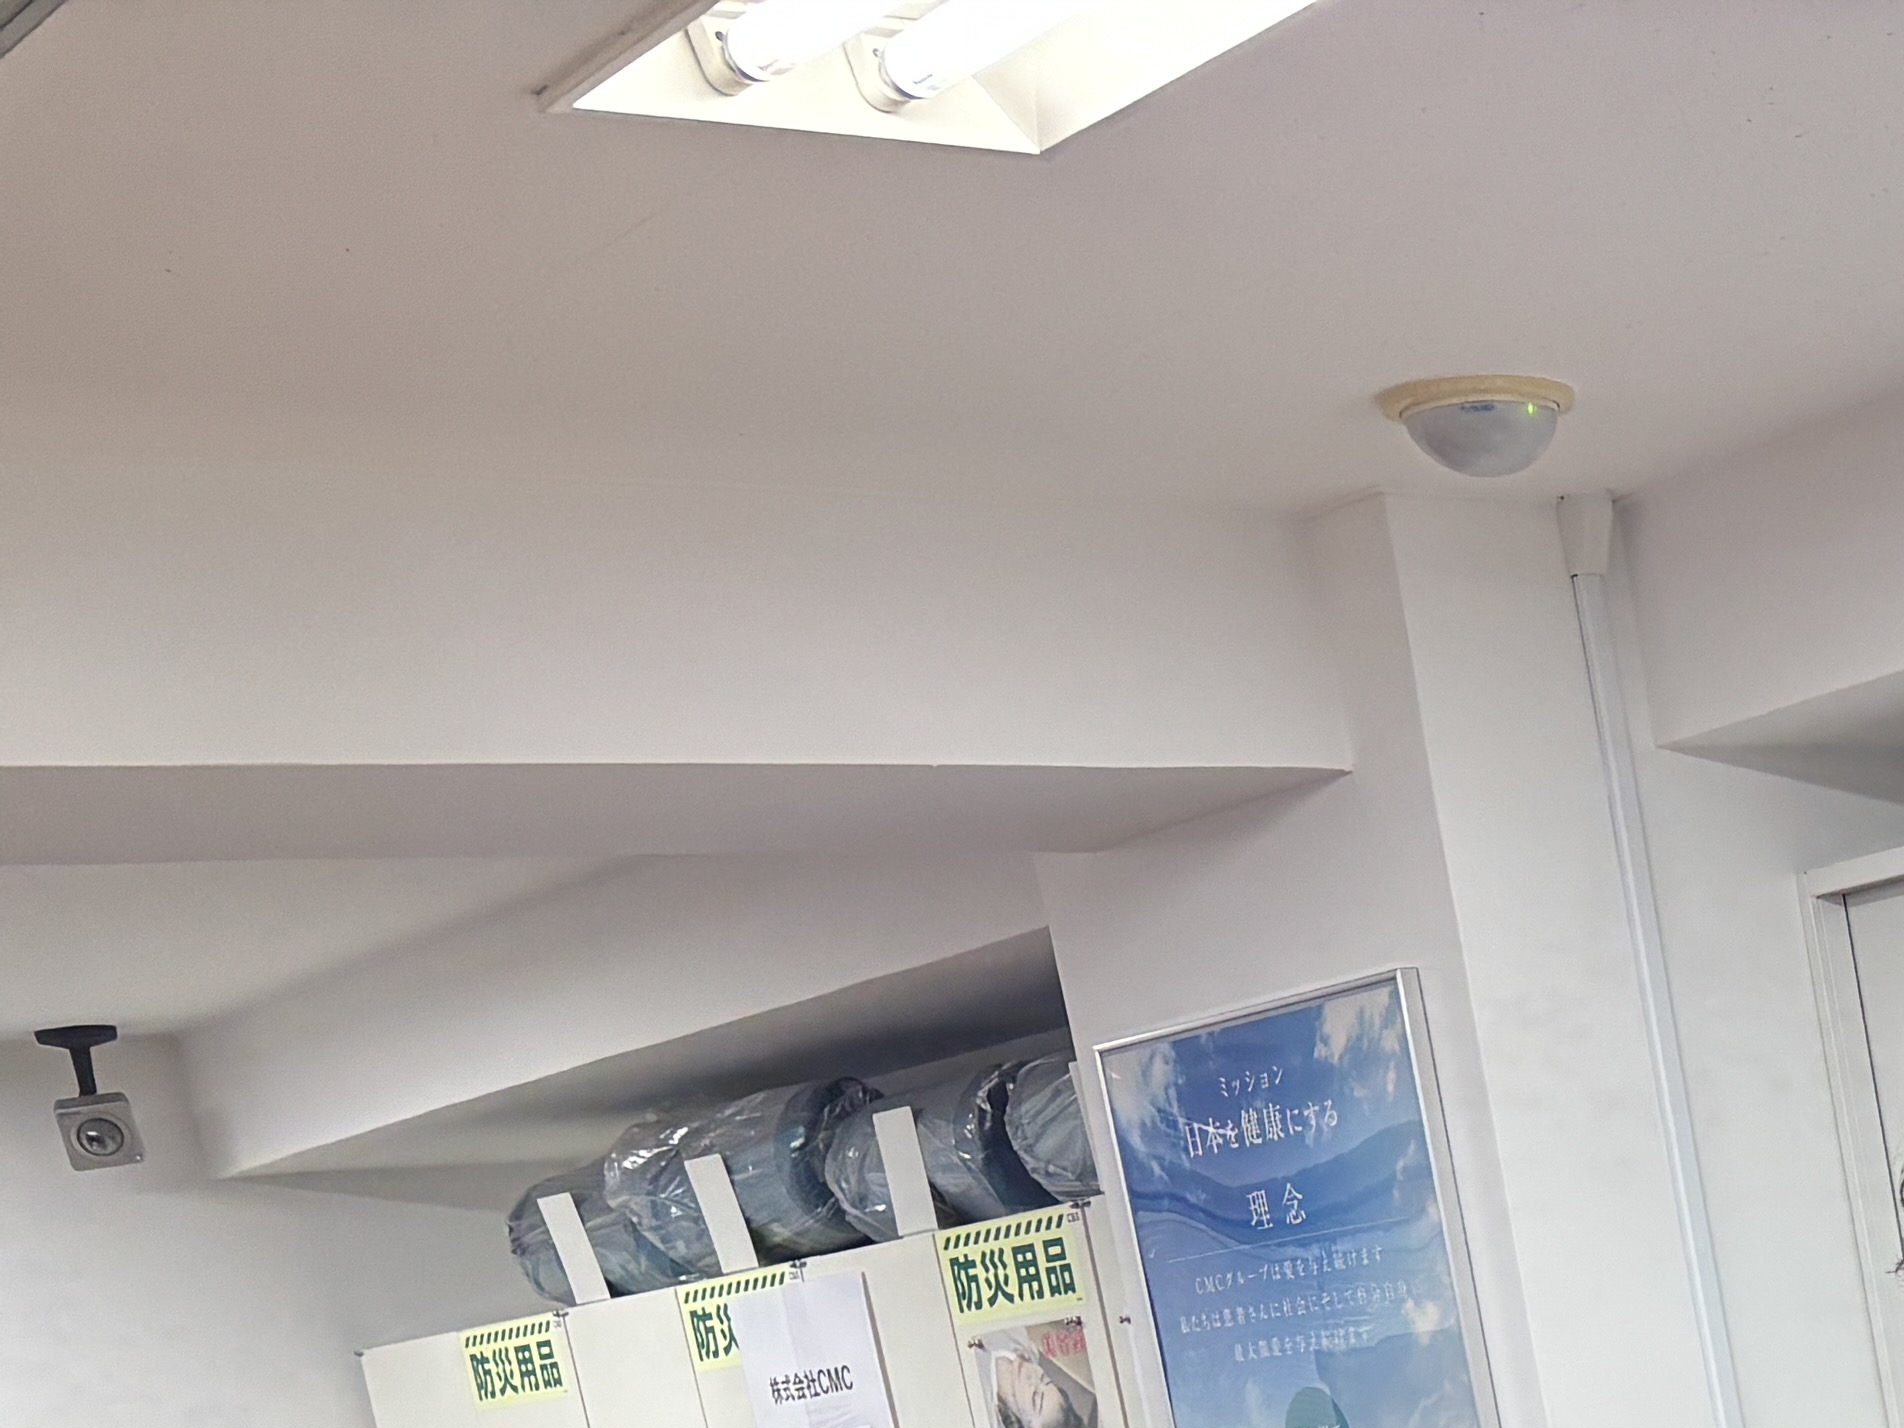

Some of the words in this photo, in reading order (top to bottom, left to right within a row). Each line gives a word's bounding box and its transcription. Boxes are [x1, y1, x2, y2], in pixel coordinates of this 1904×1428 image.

[1218, 1066, 1283, 1097] ミッション
[1184, 1099, 1338, 1158] 日本を健康にする
[1246, 1182, 1306, 1231] 理念
[948, 1237, 1076, 1314] 防災用品
[469, 1339, 563, 1402] 防災用品
[770, 1364, 853, 1405] 株式会社CMC
